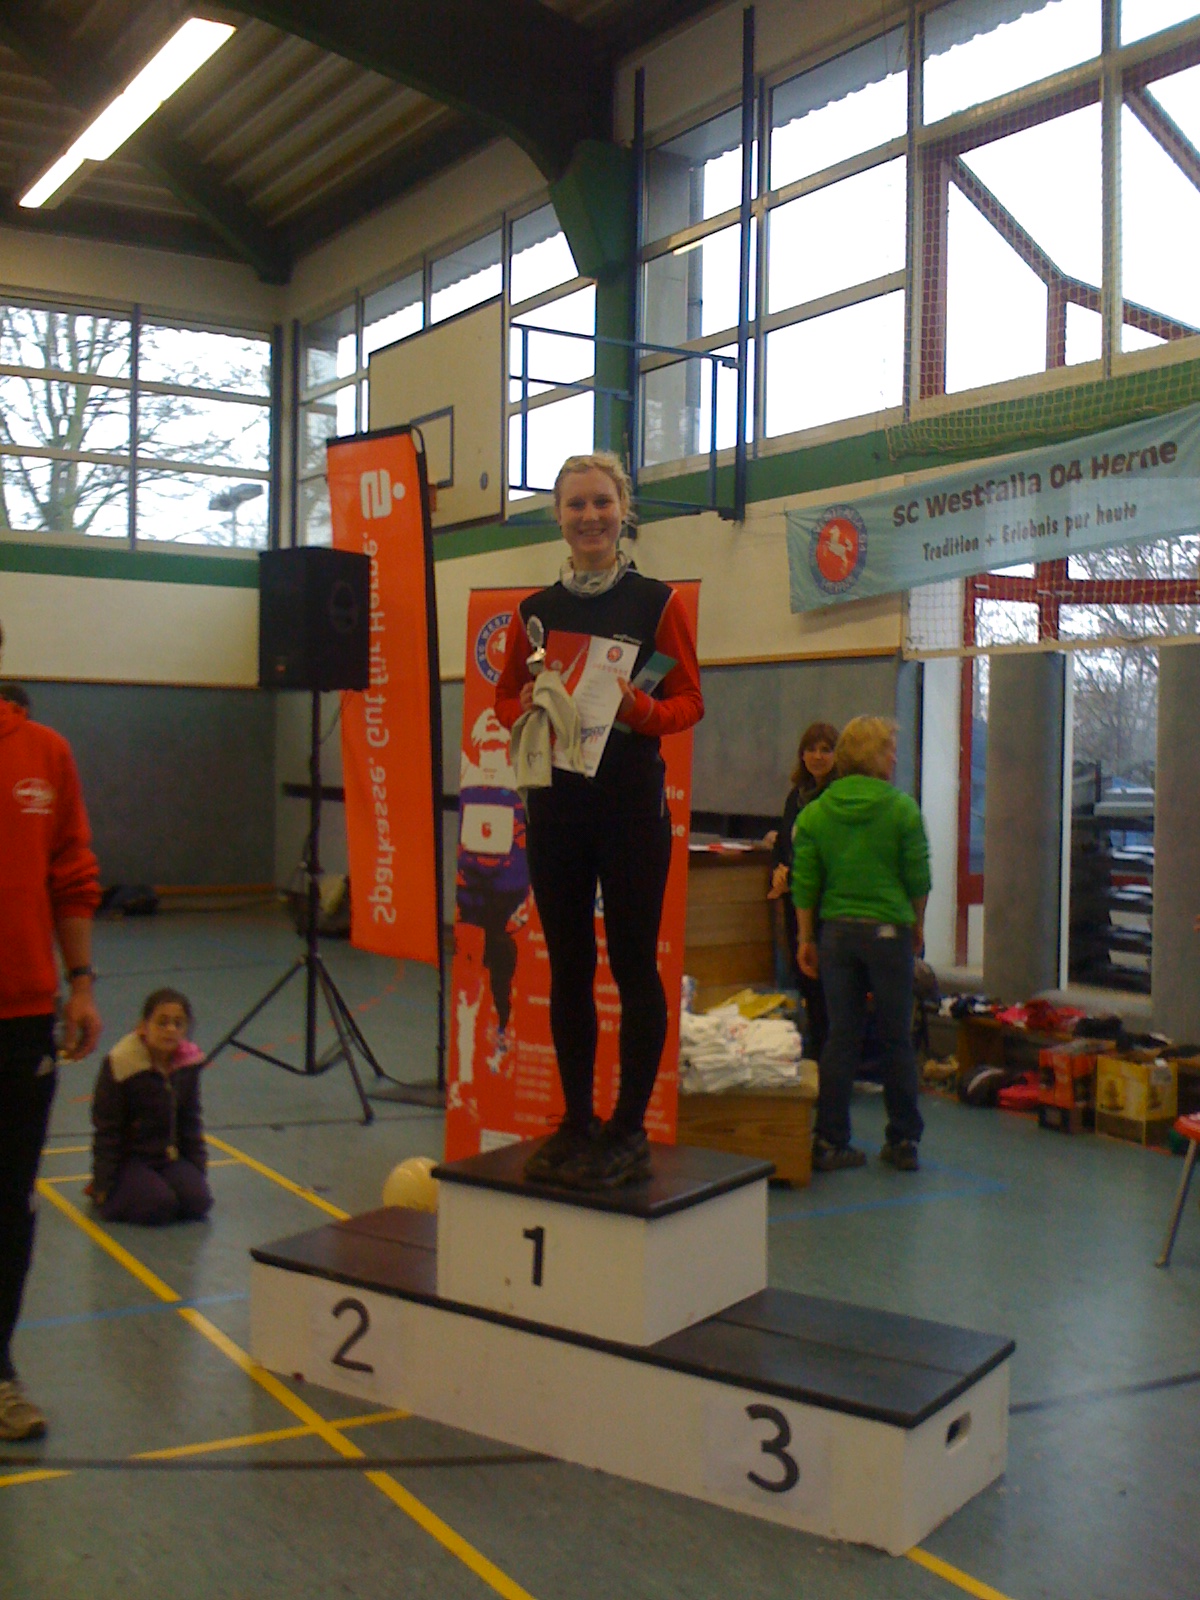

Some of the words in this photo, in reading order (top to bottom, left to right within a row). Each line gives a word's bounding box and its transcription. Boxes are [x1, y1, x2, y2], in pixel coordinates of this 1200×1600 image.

[893, 501, 919, 528] SC
[925, 472, 1041, 518] Westfalia
[1050, 459, 1083, 489] 04
[1091, 441, 1177, 479] Herne
[922, 535, 979, 561] Tradition
[1002, 515, 1058, 543] Erlebnis
[1065, 512, 1090, 537] pur
[1096, 501, 1137, 525] heute
[522, 1226, 545, 1287] 1
[331, 1297, 374, 1373] 2
[746, 1403, 800, 1493] 3
